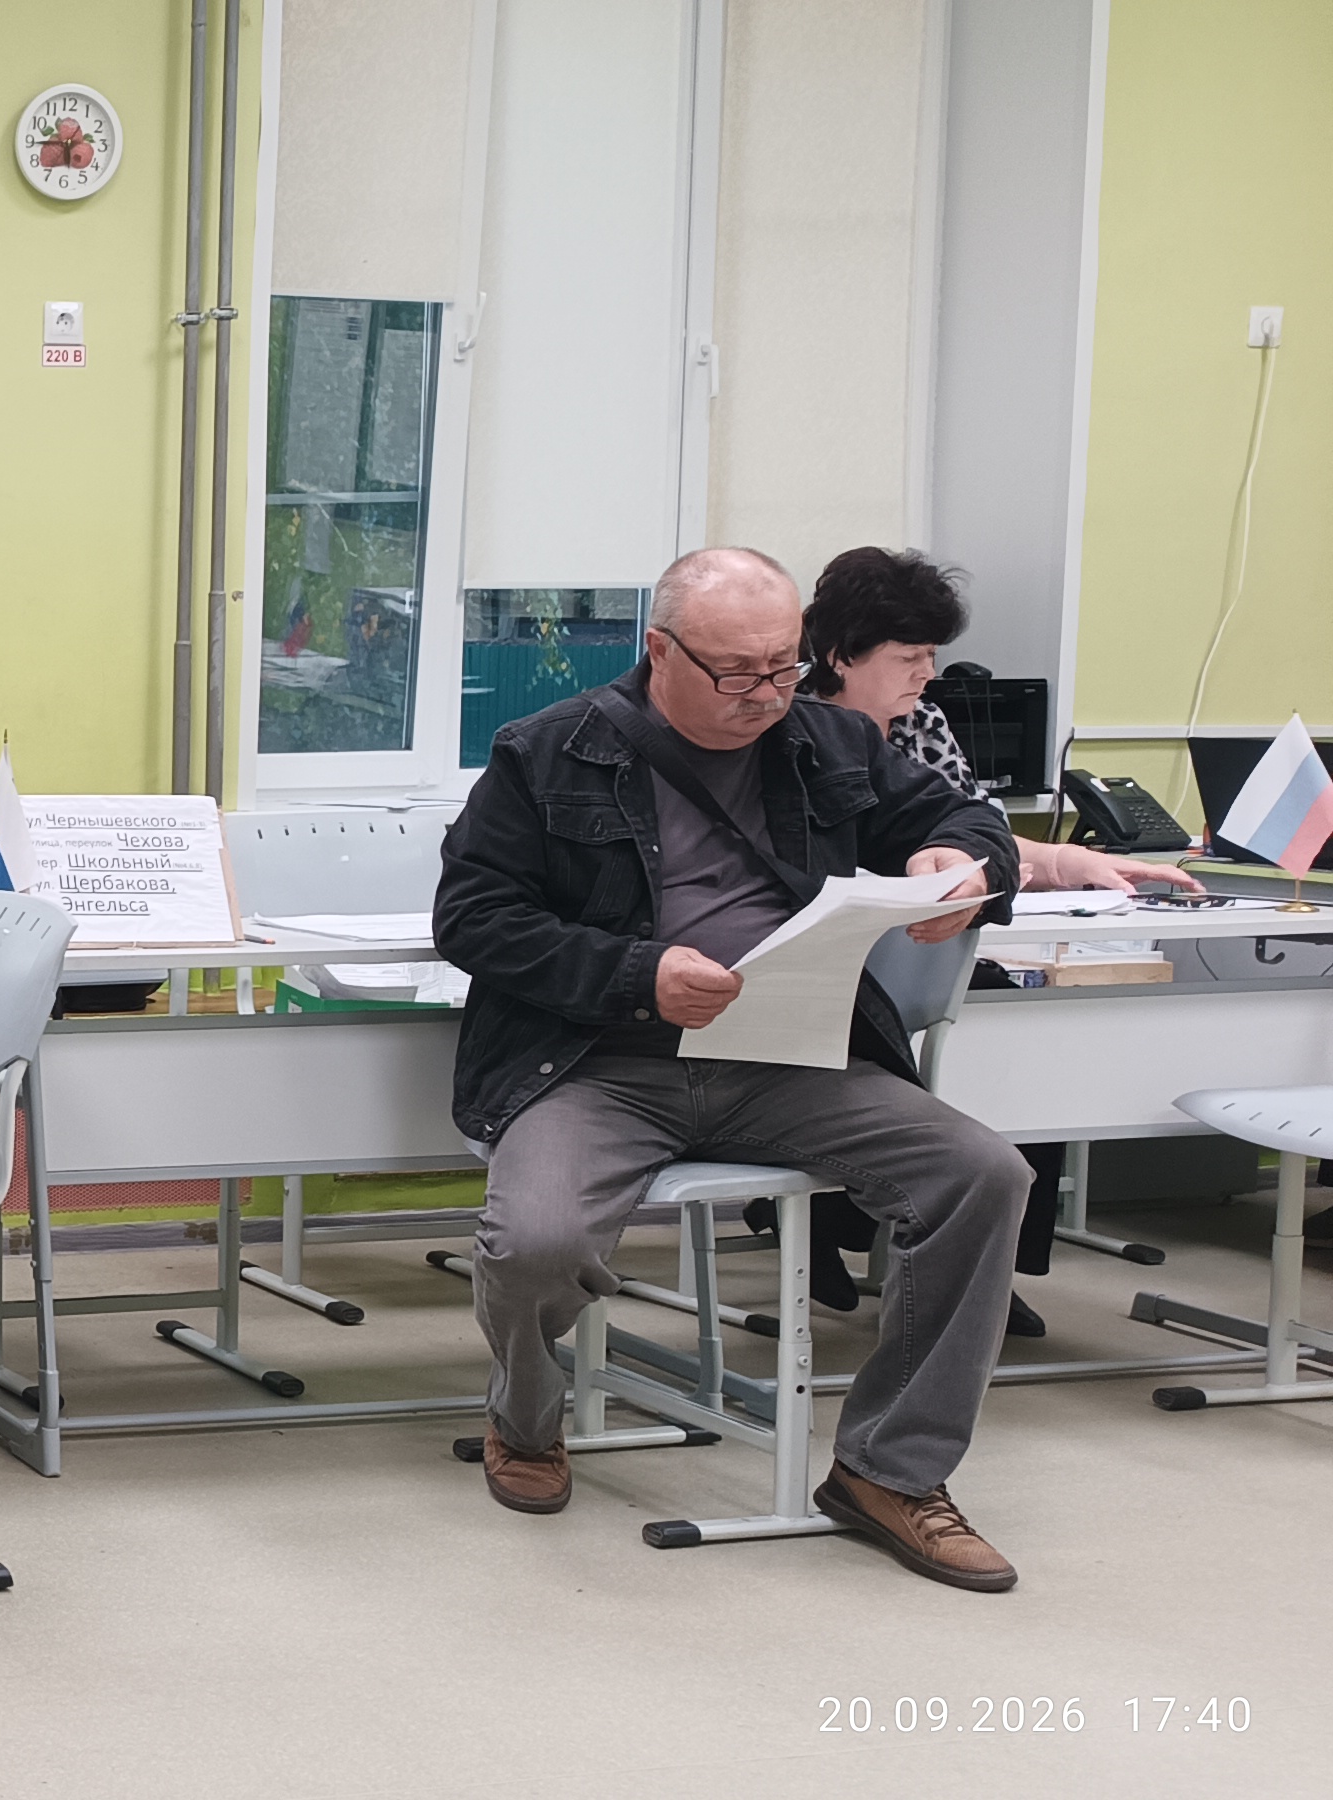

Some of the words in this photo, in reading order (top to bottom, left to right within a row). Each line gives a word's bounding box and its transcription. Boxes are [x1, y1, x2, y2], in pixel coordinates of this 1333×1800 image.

[46, 102, 57, 116] 11
[63, 97, 78, 112] 12
[84, 104, 90, 118] 1
[32, 116, 47, 130] 10
[93, 119, 103, 133] 2
[25, 134, 35, 148] 9
[97, 139, 108, 152] 3
[29, 154, 39, 168] 8
[90, 158, 100, 171] 4
[43, 168, 52, 182] 7
[58, 174, 69, 188] 6
[77, 170, 88, 184] 5
[46, 350, 69, 362] 220
[73, 350, 82, 362] В
[32, 840, 62, 849] лица,
[65, 840, 113, 849] переулок
[117, 832, 190, 850] Чехова,
[68, 853, 172, 869] Школьный
[36, 881, 55, 892] ул.
[59, 875, 177, 894] Щербакова,
[62, 897, 149, 913] Энгельса
